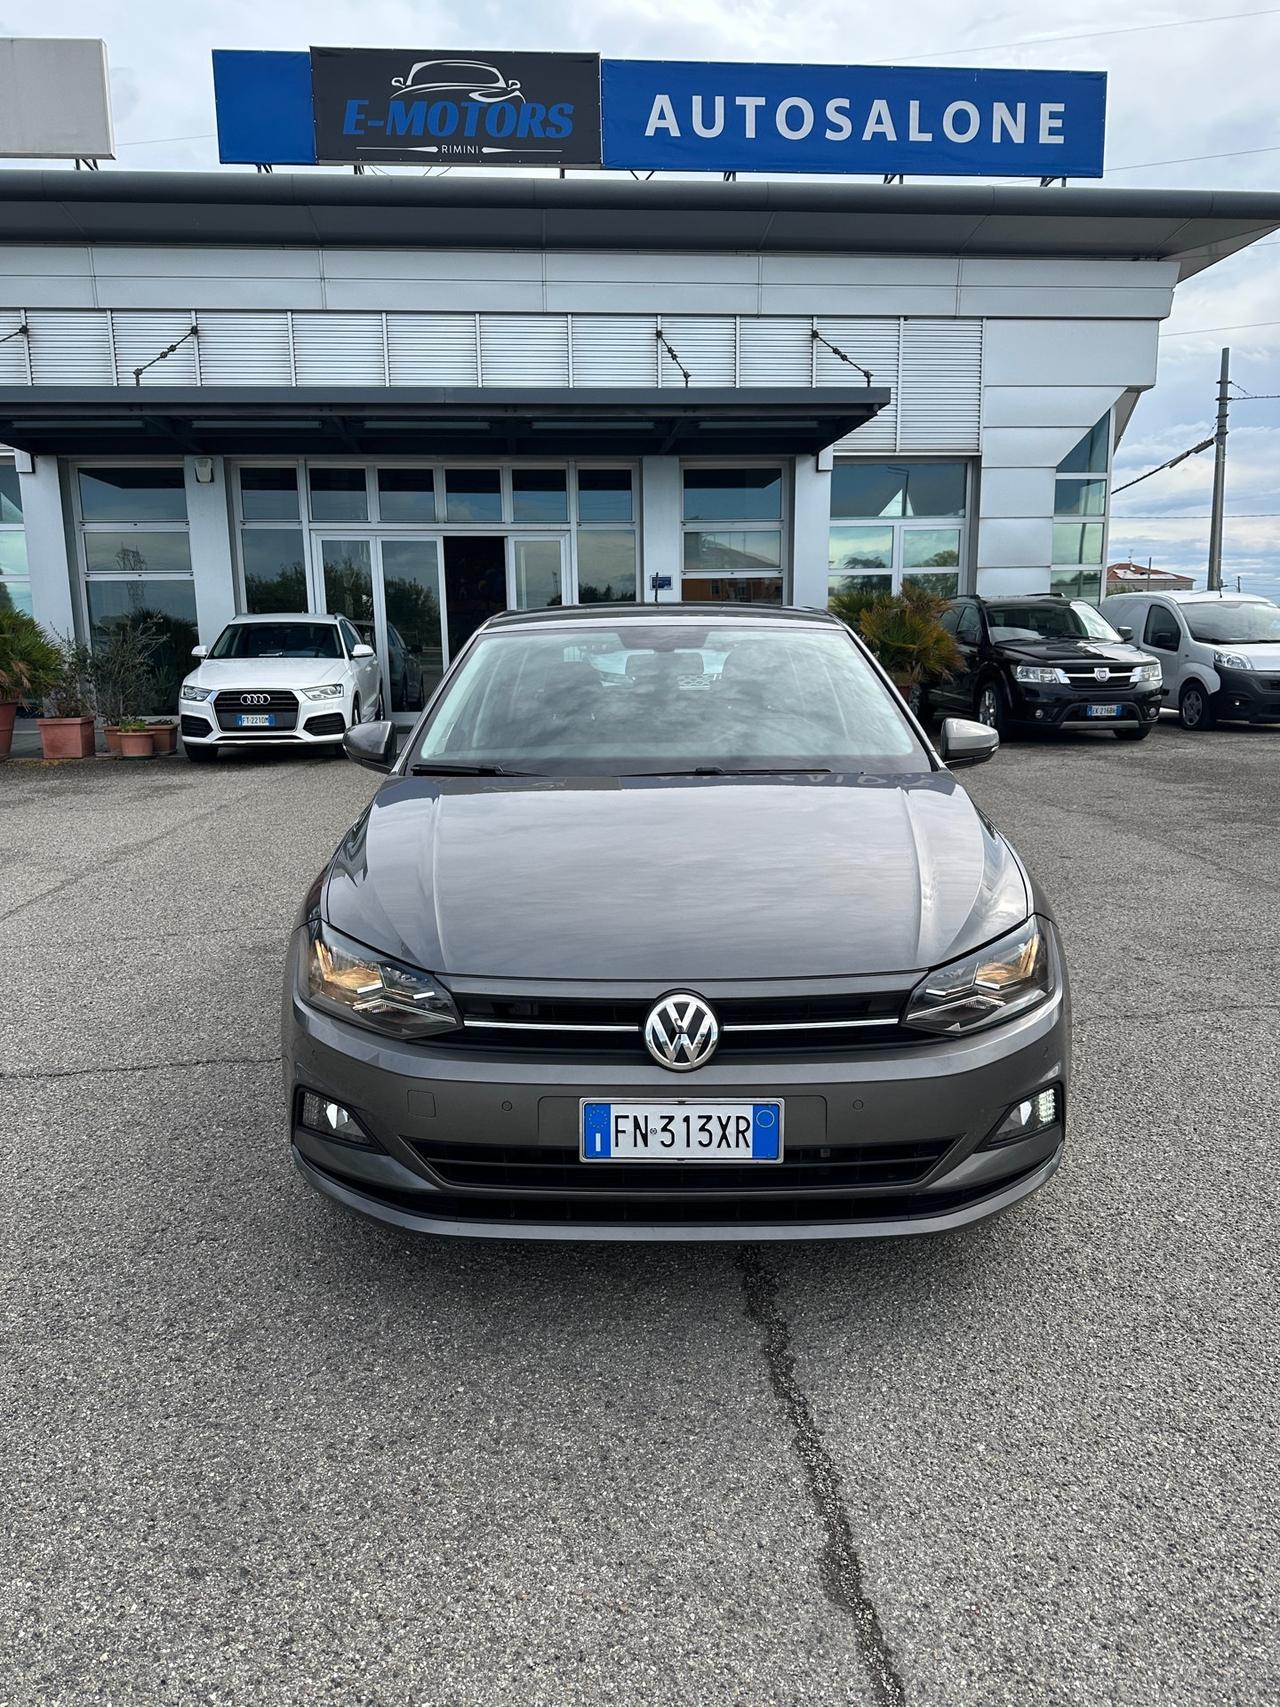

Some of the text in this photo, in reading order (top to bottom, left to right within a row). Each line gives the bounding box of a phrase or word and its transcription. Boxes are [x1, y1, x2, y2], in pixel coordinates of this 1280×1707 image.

[343, 99, 575, 139] E-MOTORS
[643, 94, 1066, 144] AUTOSALONE
[441, 143, 479, 155] RIMINI
